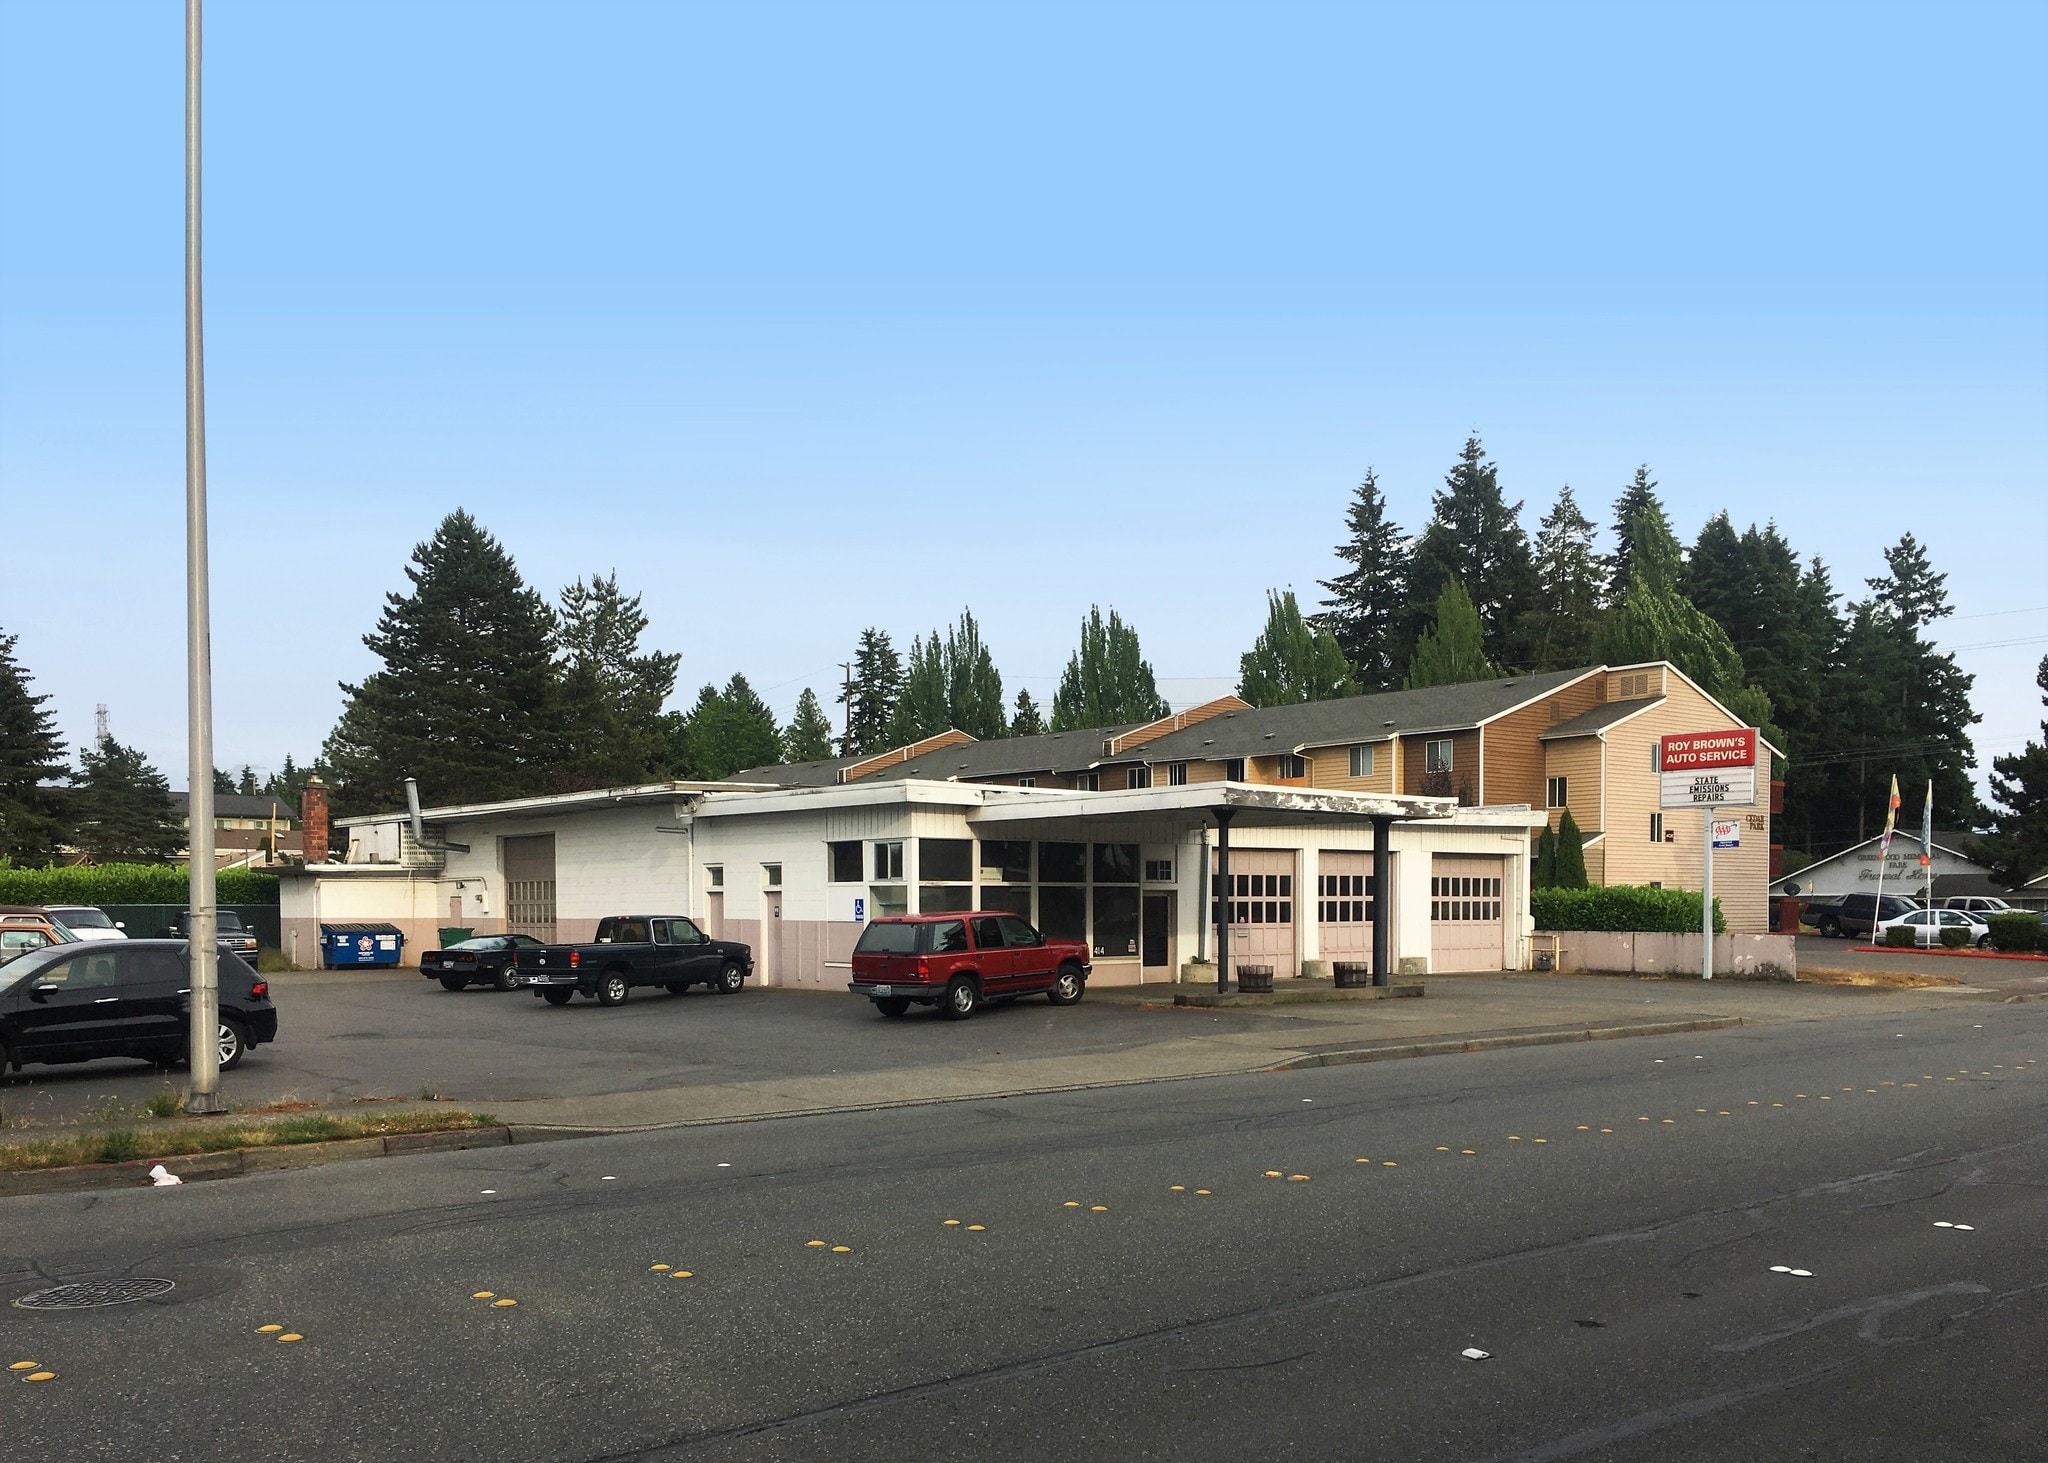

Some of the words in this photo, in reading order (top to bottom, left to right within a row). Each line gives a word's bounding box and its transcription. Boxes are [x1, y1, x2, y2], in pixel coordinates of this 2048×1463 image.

[1668, 741, 1690, 752] ROY
[1693, 737, 1746, 750] BROWN'S
[1666, 753, 1697, 764] AUTO
[1699, 749, 1747, 762] SERVICE
[1695, 776, 1719, 785] STATE
[1689, 784, 1730, 793] EMISSIONS
[1693, 793, 1725, 802] REPAIRS
